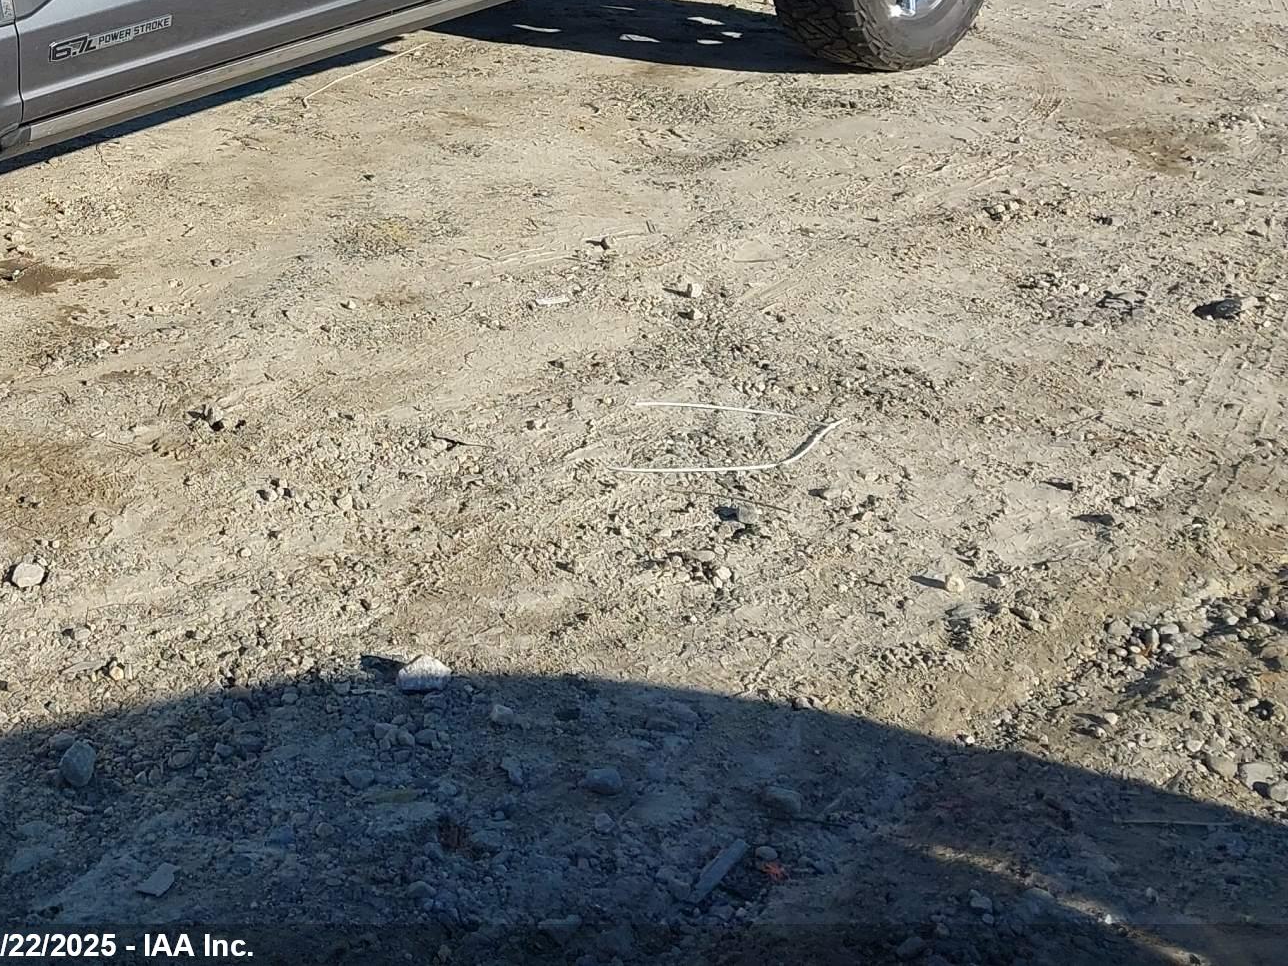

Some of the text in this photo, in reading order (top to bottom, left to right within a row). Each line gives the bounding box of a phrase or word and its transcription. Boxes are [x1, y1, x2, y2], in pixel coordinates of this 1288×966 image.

[49, 17, 171, 62] 6.7L POWER STROKE
